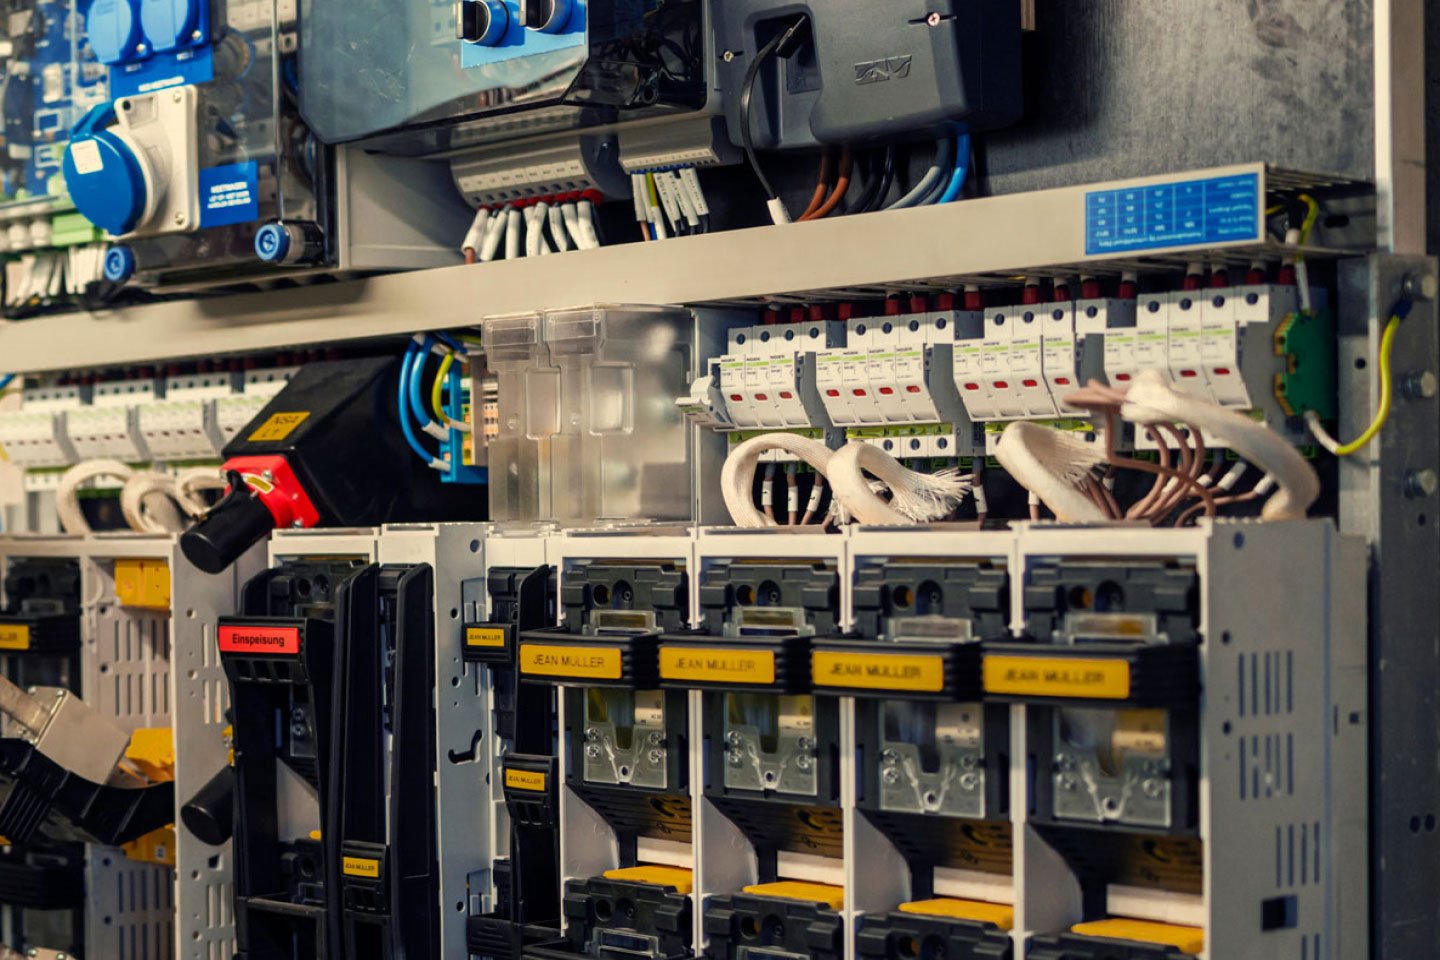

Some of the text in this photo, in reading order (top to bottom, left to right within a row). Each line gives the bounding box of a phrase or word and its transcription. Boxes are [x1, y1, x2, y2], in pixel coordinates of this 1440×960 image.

[232, 633, 285, 647] Einspeisung
[533, 654, 558, 666] JEAN
[675, 657, 703, 669] JEAN
[830, 663, 862, 676] JEAN
